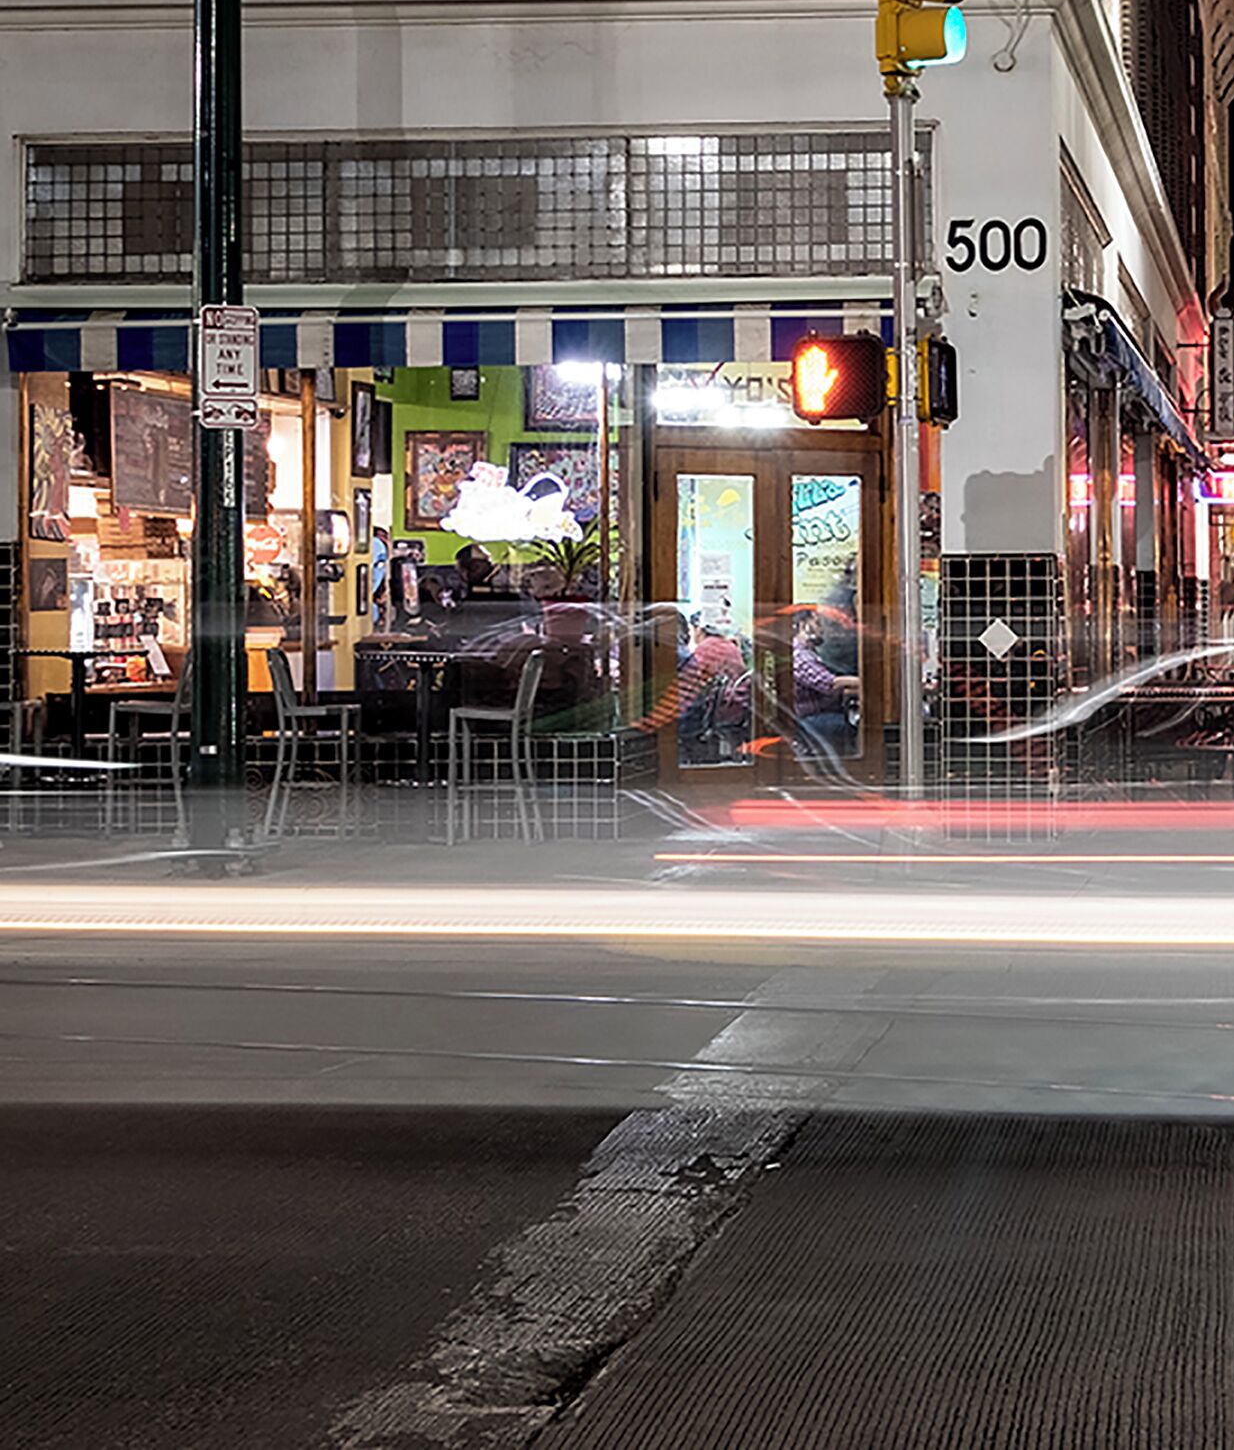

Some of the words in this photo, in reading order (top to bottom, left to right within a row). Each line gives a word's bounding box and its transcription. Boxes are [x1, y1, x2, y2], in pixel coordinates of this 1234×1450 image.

[945, 217, 1047, 272] 500
[205, 310, 222, 327] NO
[217, 349, 240, 359] ANY
[216, 363, 243, 375] TIME
